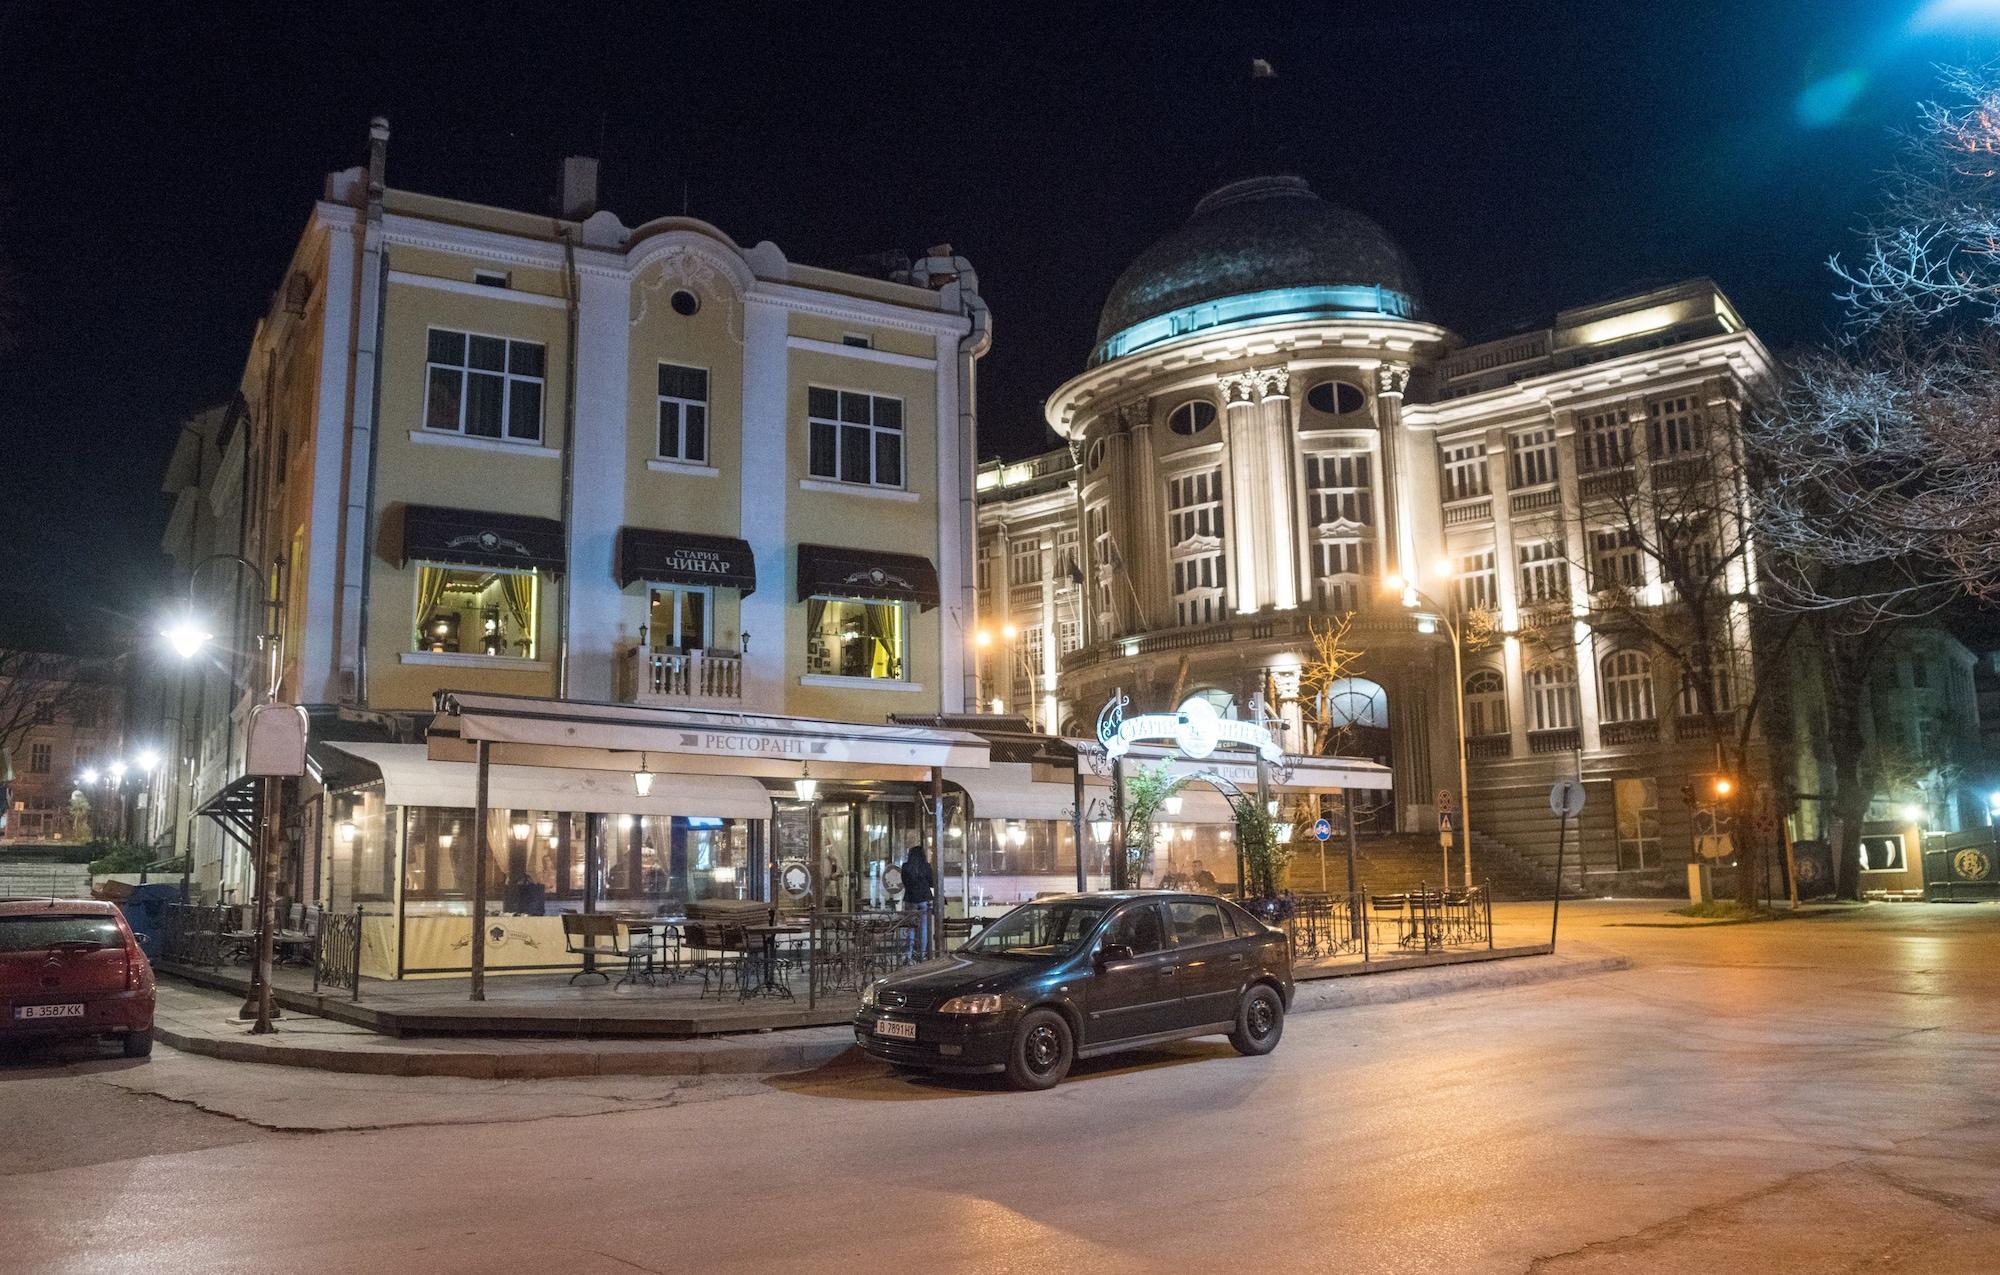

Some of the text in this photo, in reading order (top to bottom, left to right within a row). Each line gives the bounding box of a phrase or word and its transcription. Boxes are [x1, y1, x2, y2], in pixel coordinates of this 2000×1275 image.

[674, 549, 720, 561] СТАРИЯ
[665, 557, 730, 574] ЧИНАР
[705, 734, 805, 753] РЕСТОРАНТ
[26, 1007, 34, 1017] B
